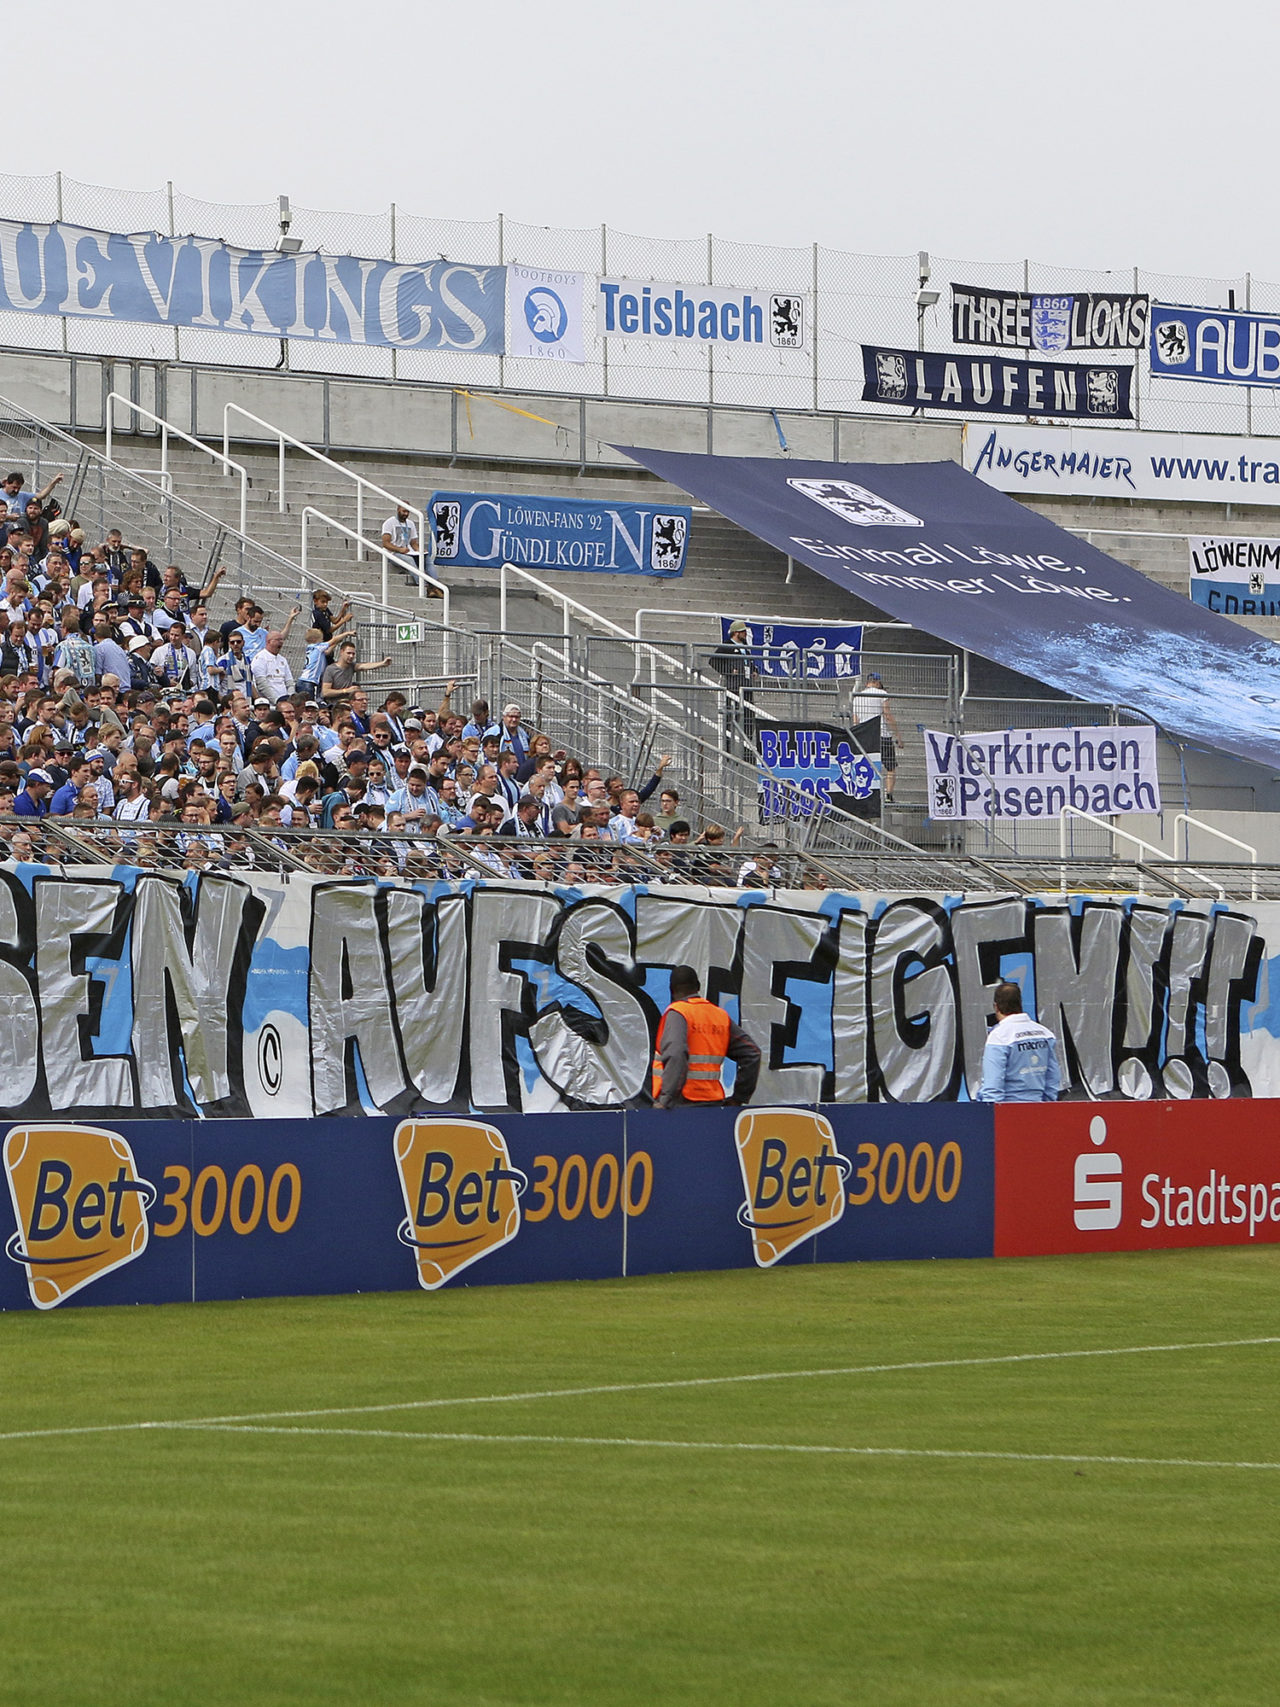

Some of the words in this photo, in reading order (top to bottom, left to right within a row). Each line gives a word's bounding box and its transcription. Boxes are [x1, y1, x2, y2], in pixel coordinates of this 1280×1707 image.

[127, 231, 491, 350] VIKINGS
[514, 267, 577, 285] BOOTBOYS
[600, 282, 764, 343] Teisbach
[954, 293, 1031, 346] THREE
[1034, 297, 1069, 310] 1860
[1071, 298, 1148, 347] LIONS
[529, 345, 566, 359] 1860
[776, 337, 797, 347] 1860
[915, 358, 1077, 411] LAUFEN
[972, 429, 1137, 490] ANGERMAIER
[1150, 454, 1280, 484] www.tra
[507, 506, 584, 529] LÖWEN-FANS
[790, 536, 954, 566] Einmal
[942, 543, 1088, 574] Löwe,
[842, 565, 996, 595] immer
[990, 573, 1133, 602] Löwe.
[759, 730, 832, 769] BLUE
[928, 731, 1140, 776] Vierkirchen
[960, 773, 1157, 817] Pasenbach
[524, 1150, 653, 1223] 3000
[848, 1141, 962, 1206] 3000
[155, 1163, 301, 1237] 3000
